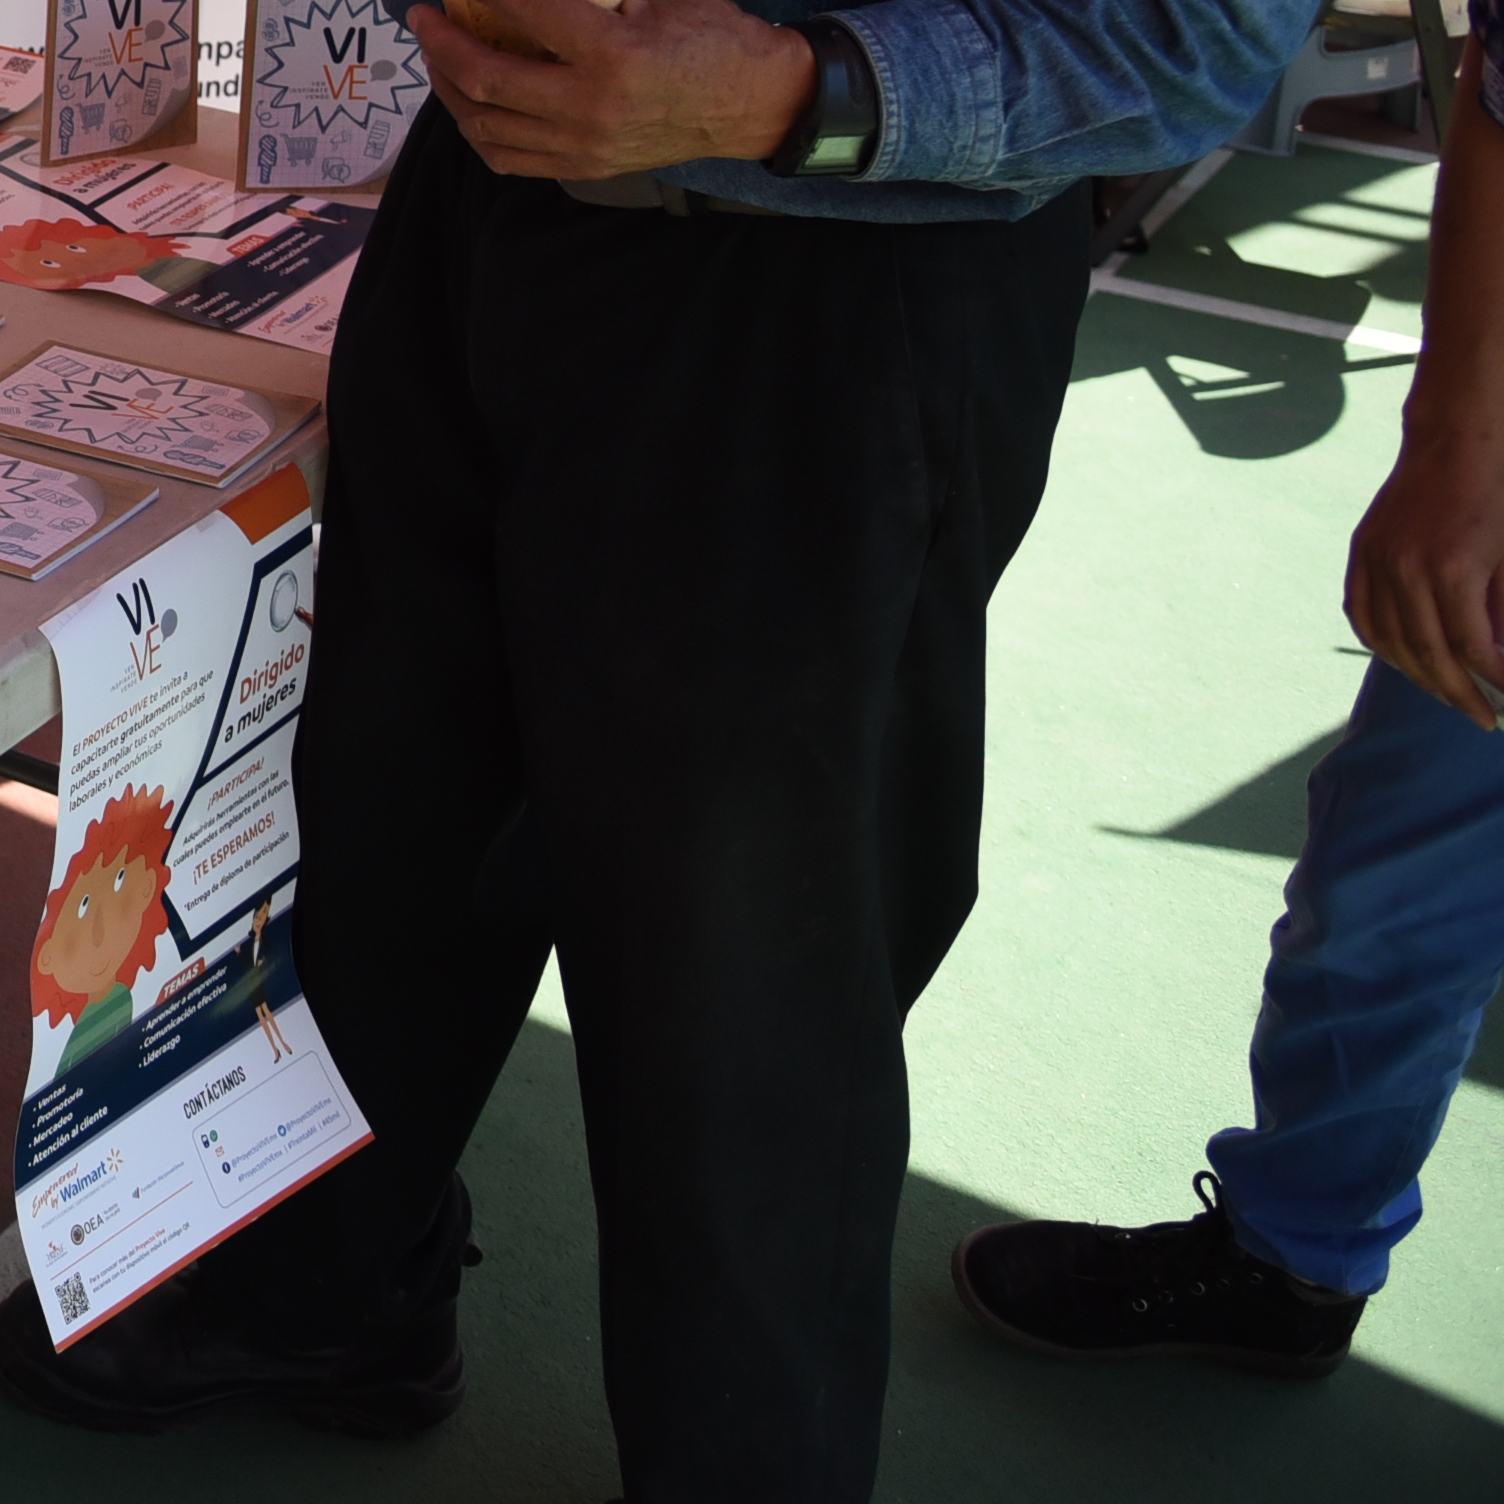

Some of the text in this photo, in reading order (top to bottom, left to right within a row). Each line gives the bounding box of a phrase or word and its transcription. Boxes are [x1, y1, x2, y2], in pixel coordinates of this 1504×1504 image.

[108, 27, 144, 65] VE
[323, 26, 367, 64] VI
[322, 64, 369, 100] VE
[69, 390, 131, 411] VI
[111, 398, 175, 420] VE
[116, 577, 155, 636] VI
[130, 624, 162, 681] VE
[239, 642, 305, 705] Dirigido
[70, 670, 214, 775] capacitarte gratuitamente para que
[72, 671, 189, 757] El PROYECTO VIVE te invita a
[224, 676, 297, 744] a mujeres
[69, 692, 206, 797] puedas ampliar tus oportunidades
[68, 739, 163, 813] laborales y económicas
[207, 756, 266, 812] ¡PARTICIPA!
[192, 810, 276, 886] ¡TE ESPERAMOS!
[162, 962, 200, 999] TEMAS
[182, 1065, 247, 1120] CONTÁCTANOS
[59, 1160, 108, 1204] Walmart
